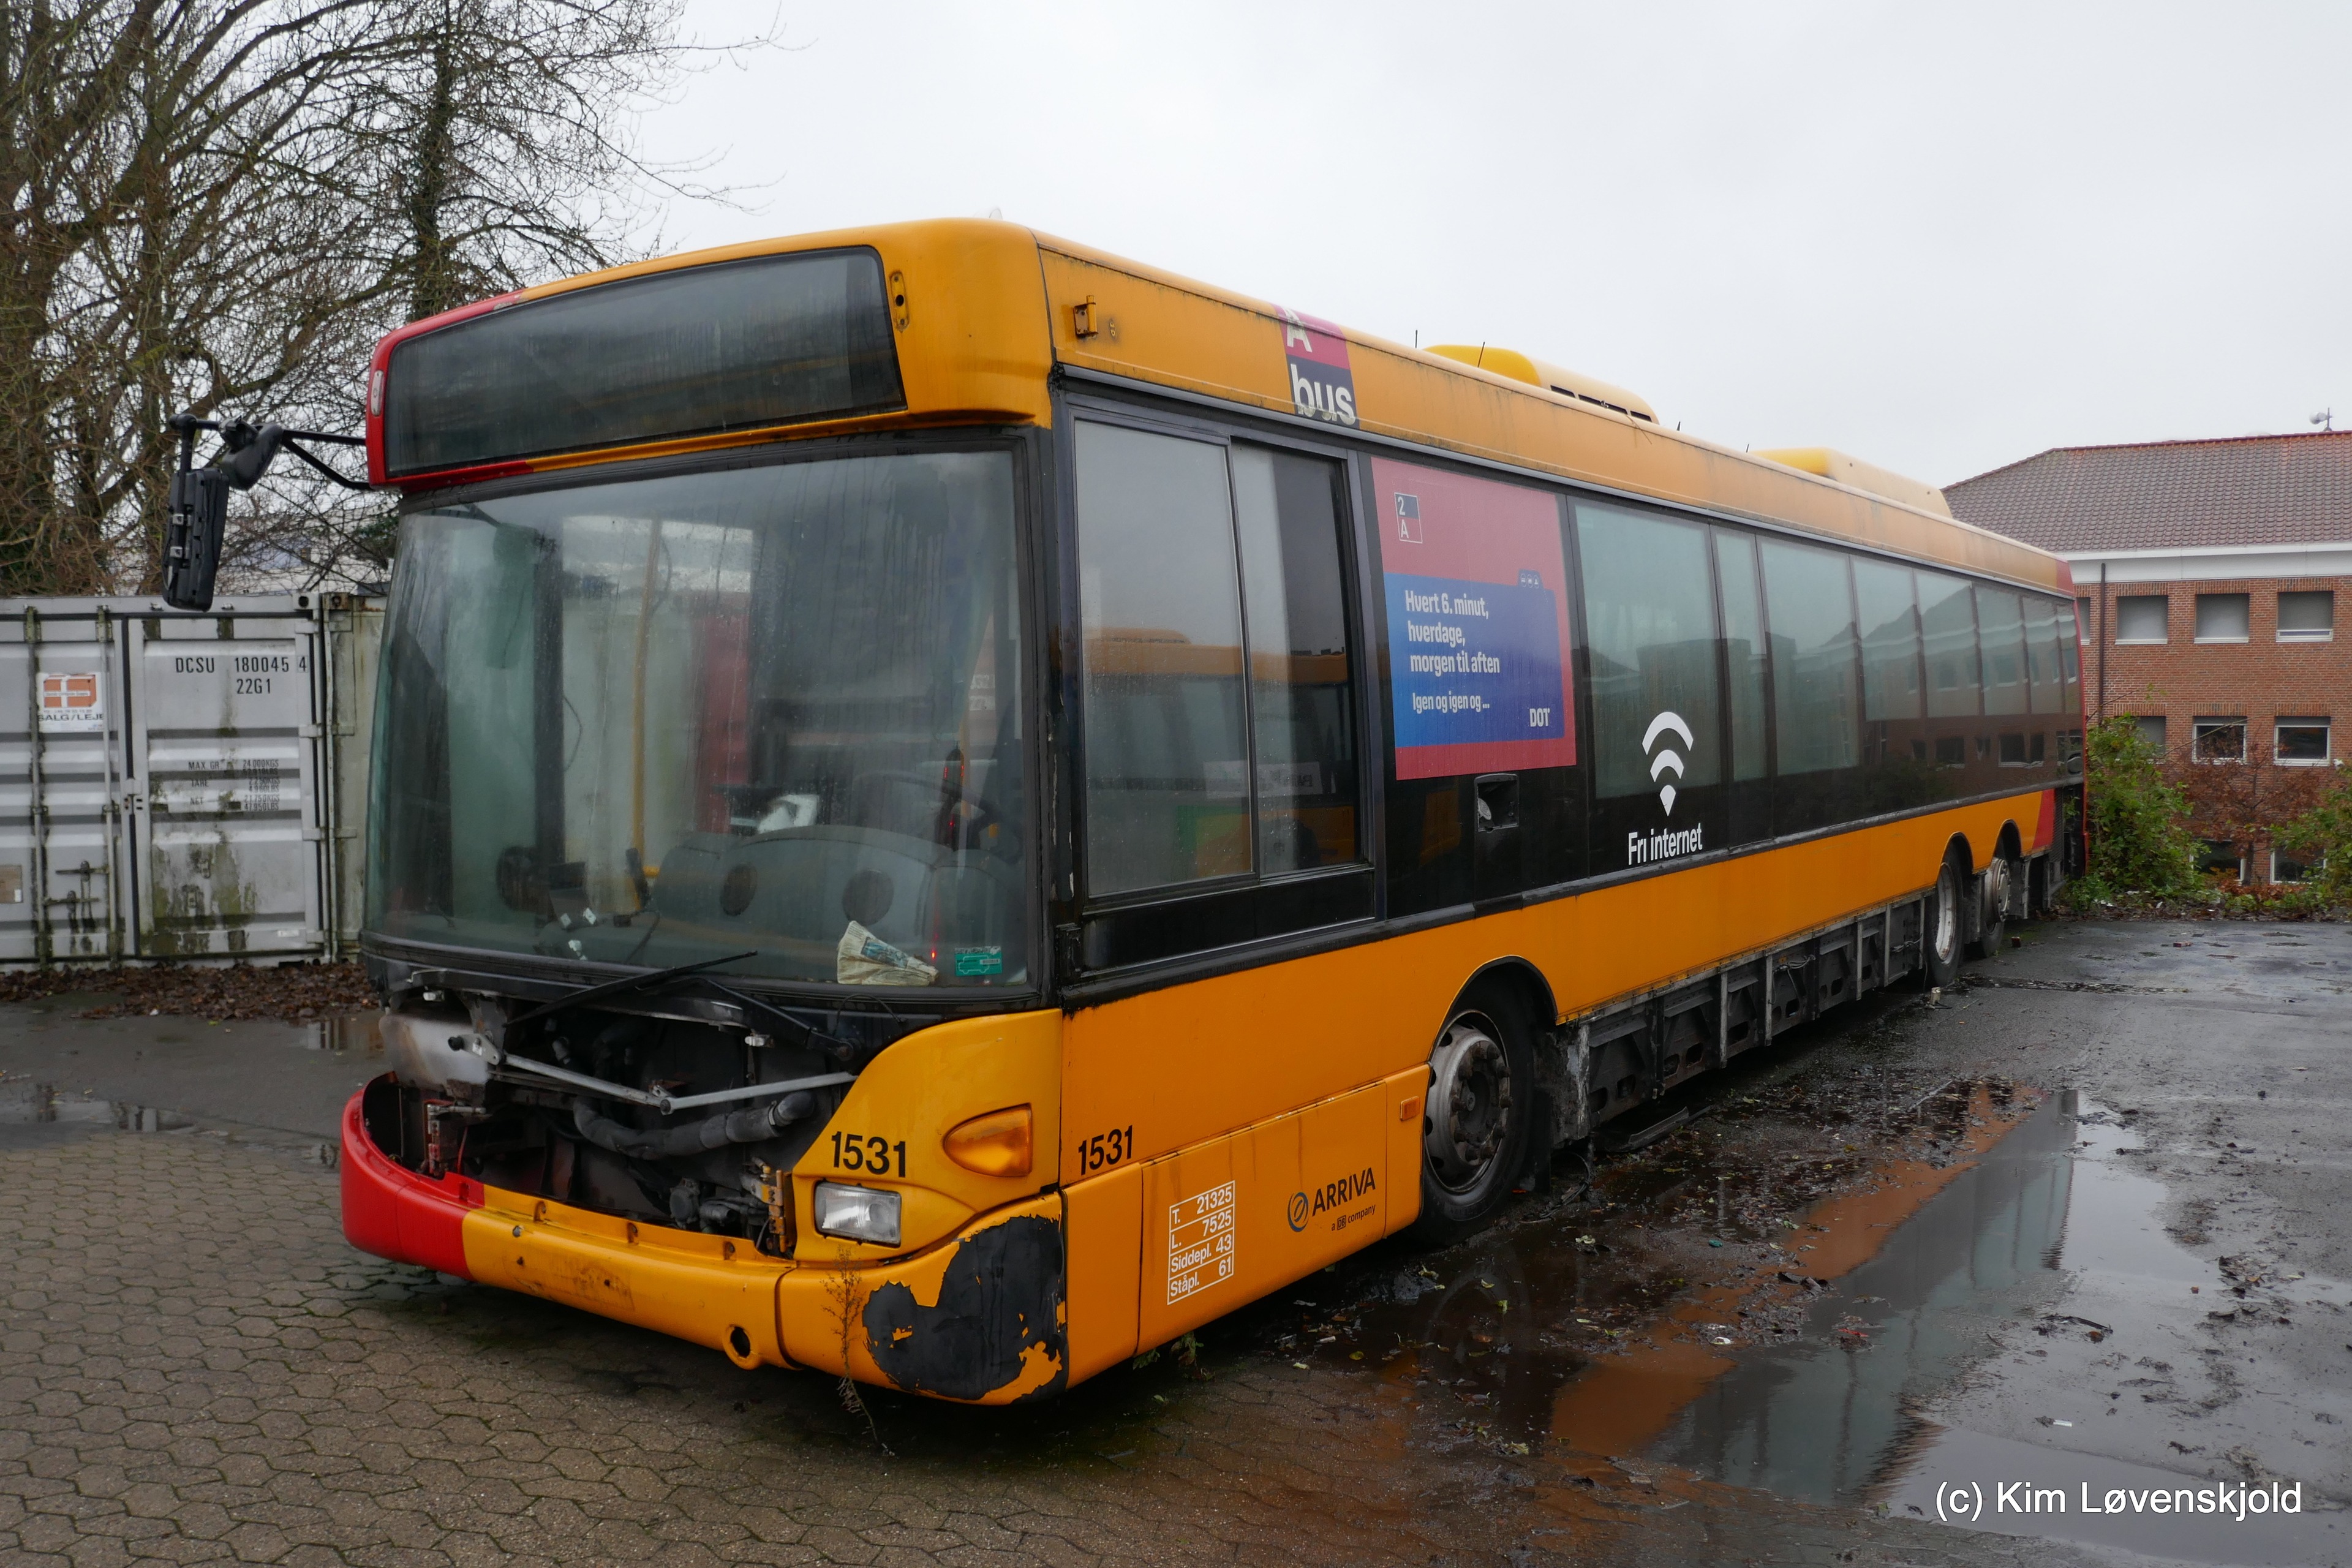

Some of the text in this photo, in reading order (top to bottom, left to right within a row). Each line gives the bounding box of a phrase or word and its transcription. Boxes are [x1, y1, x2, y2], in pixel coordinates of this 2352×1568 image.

[1283, 307, 1313, 353] A
[1291, 363, 1356, 425] bus
[1398, 496, 1406, 516] 2
[1401, 519, 1409, 538] A
[1405, 590, 1489, 619] Hvert 6. minut,
[1408, 620, 1466, 648] hverdage,
[176, 657, 307, 673] DCSU 180045 4
[1410, 650, 1500, 677] morgen til aften
[236, 678, 271, 694] 22G1
[1412, 692, 1434, 714] Igen
[1435, 697, 1447, 714] og
[1449, 690, 1469, 713] igen
[188, 761, 206, 771] MAX
[1628, 823, 1703, 865] Fri internet
[831, 1130, 907, 1178] 1531
[1077, 1125, 1134, 1176] 1531
[1172, 1186, 1232, 1224] T. 21325
[1312, 1167, 1376, 1217] ARRIVA
[1171, 1210, 1232, 1250] L. 7525
[1331, 1223, 1336, 1231] a
[1348, 1204, 1376, 1224] company
[1171, 1234, 1232, 1273] Siddepl. 43
[1170, 1256, 1232, 1298] Ståpl. 61
